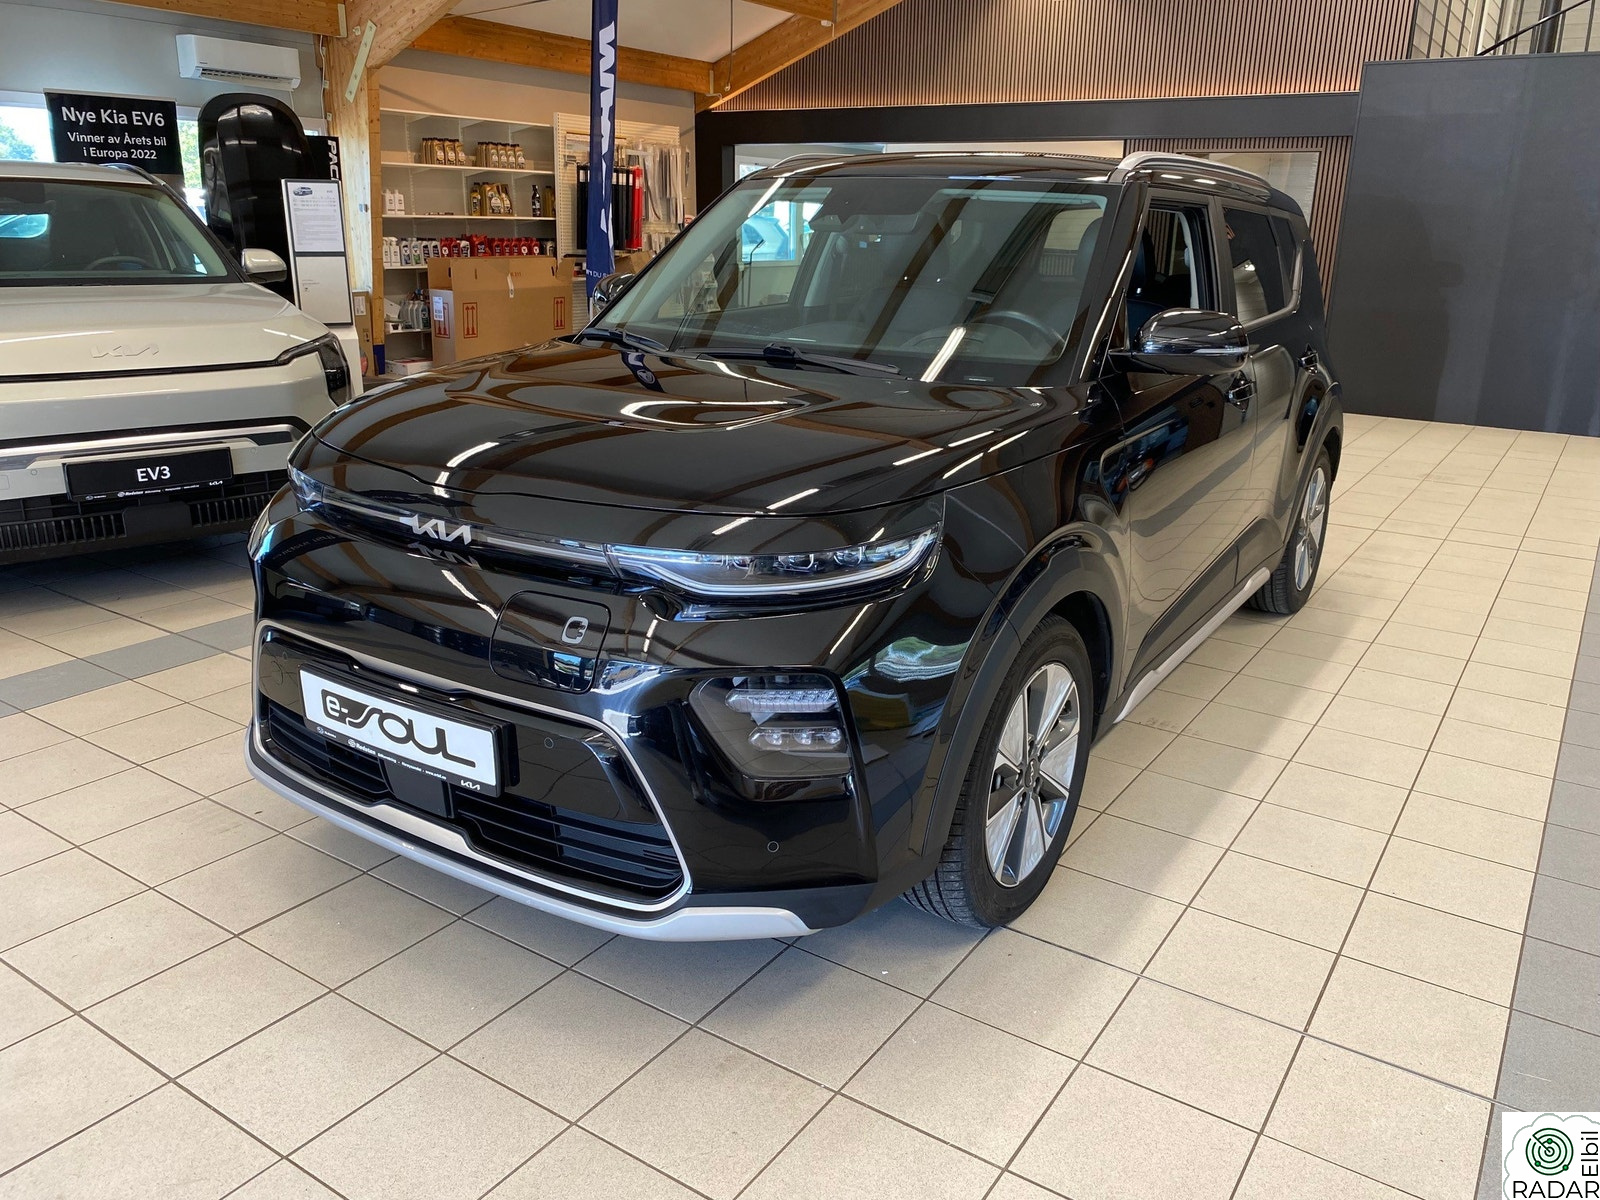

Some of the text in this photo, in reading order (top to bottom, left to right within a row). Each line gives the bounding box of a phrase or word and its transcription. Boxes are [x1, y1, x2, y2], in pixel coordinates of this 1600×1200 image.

[61, 106, 165, 127] Nye Kia EV6
[67, 132, 167, 146] Vinner av Årets bil
[83, 147, 157, 160] i Europa 2022
[136, 465, 171, 482] EV3
